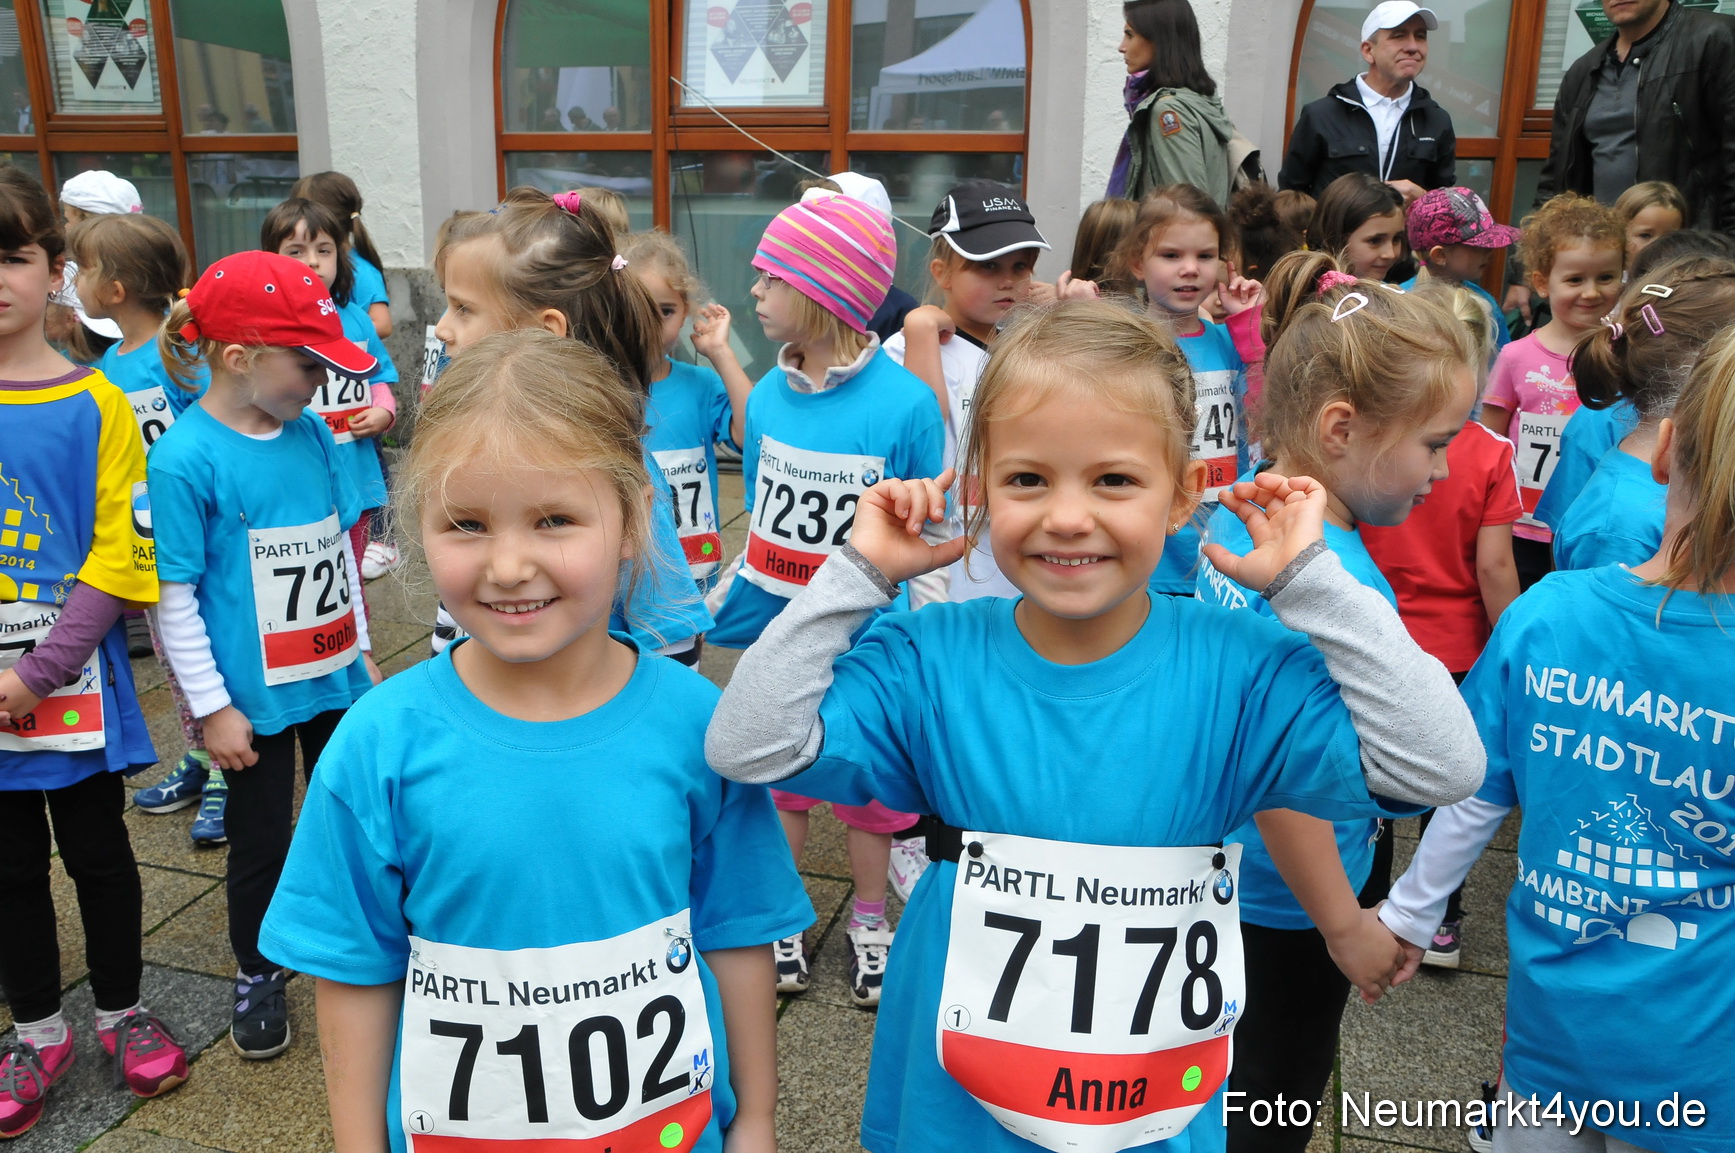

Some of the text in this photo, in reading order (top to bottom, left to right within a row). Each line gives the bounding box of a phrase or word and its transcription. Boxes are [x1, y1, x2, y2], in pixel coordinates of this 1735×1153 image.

[1522, 424, 1561, 437] PARTL
[760, 450, 854, 484] PARTL Neumarkt
[1530, 442, 1560, 483] 7
[758, 475, 860, 546] 7232
[0, 554, 36, 571] 2014
[254, 541, 314, 559] PARTL
[1526, 664, 1735, 748] NEUMARKT
[963, 860, 1206, 906] PARTL Neumarkt
[412, 958, 657, 1006] PARTL Neumarkt
[984, 910, 1223, 1035] 7178
[952, 1009, 962, 1027] 1
[1224, 1000, 1238, 1015] M
[429, 994, 690, 1123] 7102
[693, 1048, 709, 1071] M
[1046, 1067, 1148, 1112] Anna
[416, 1114, 426, 1131] 1
